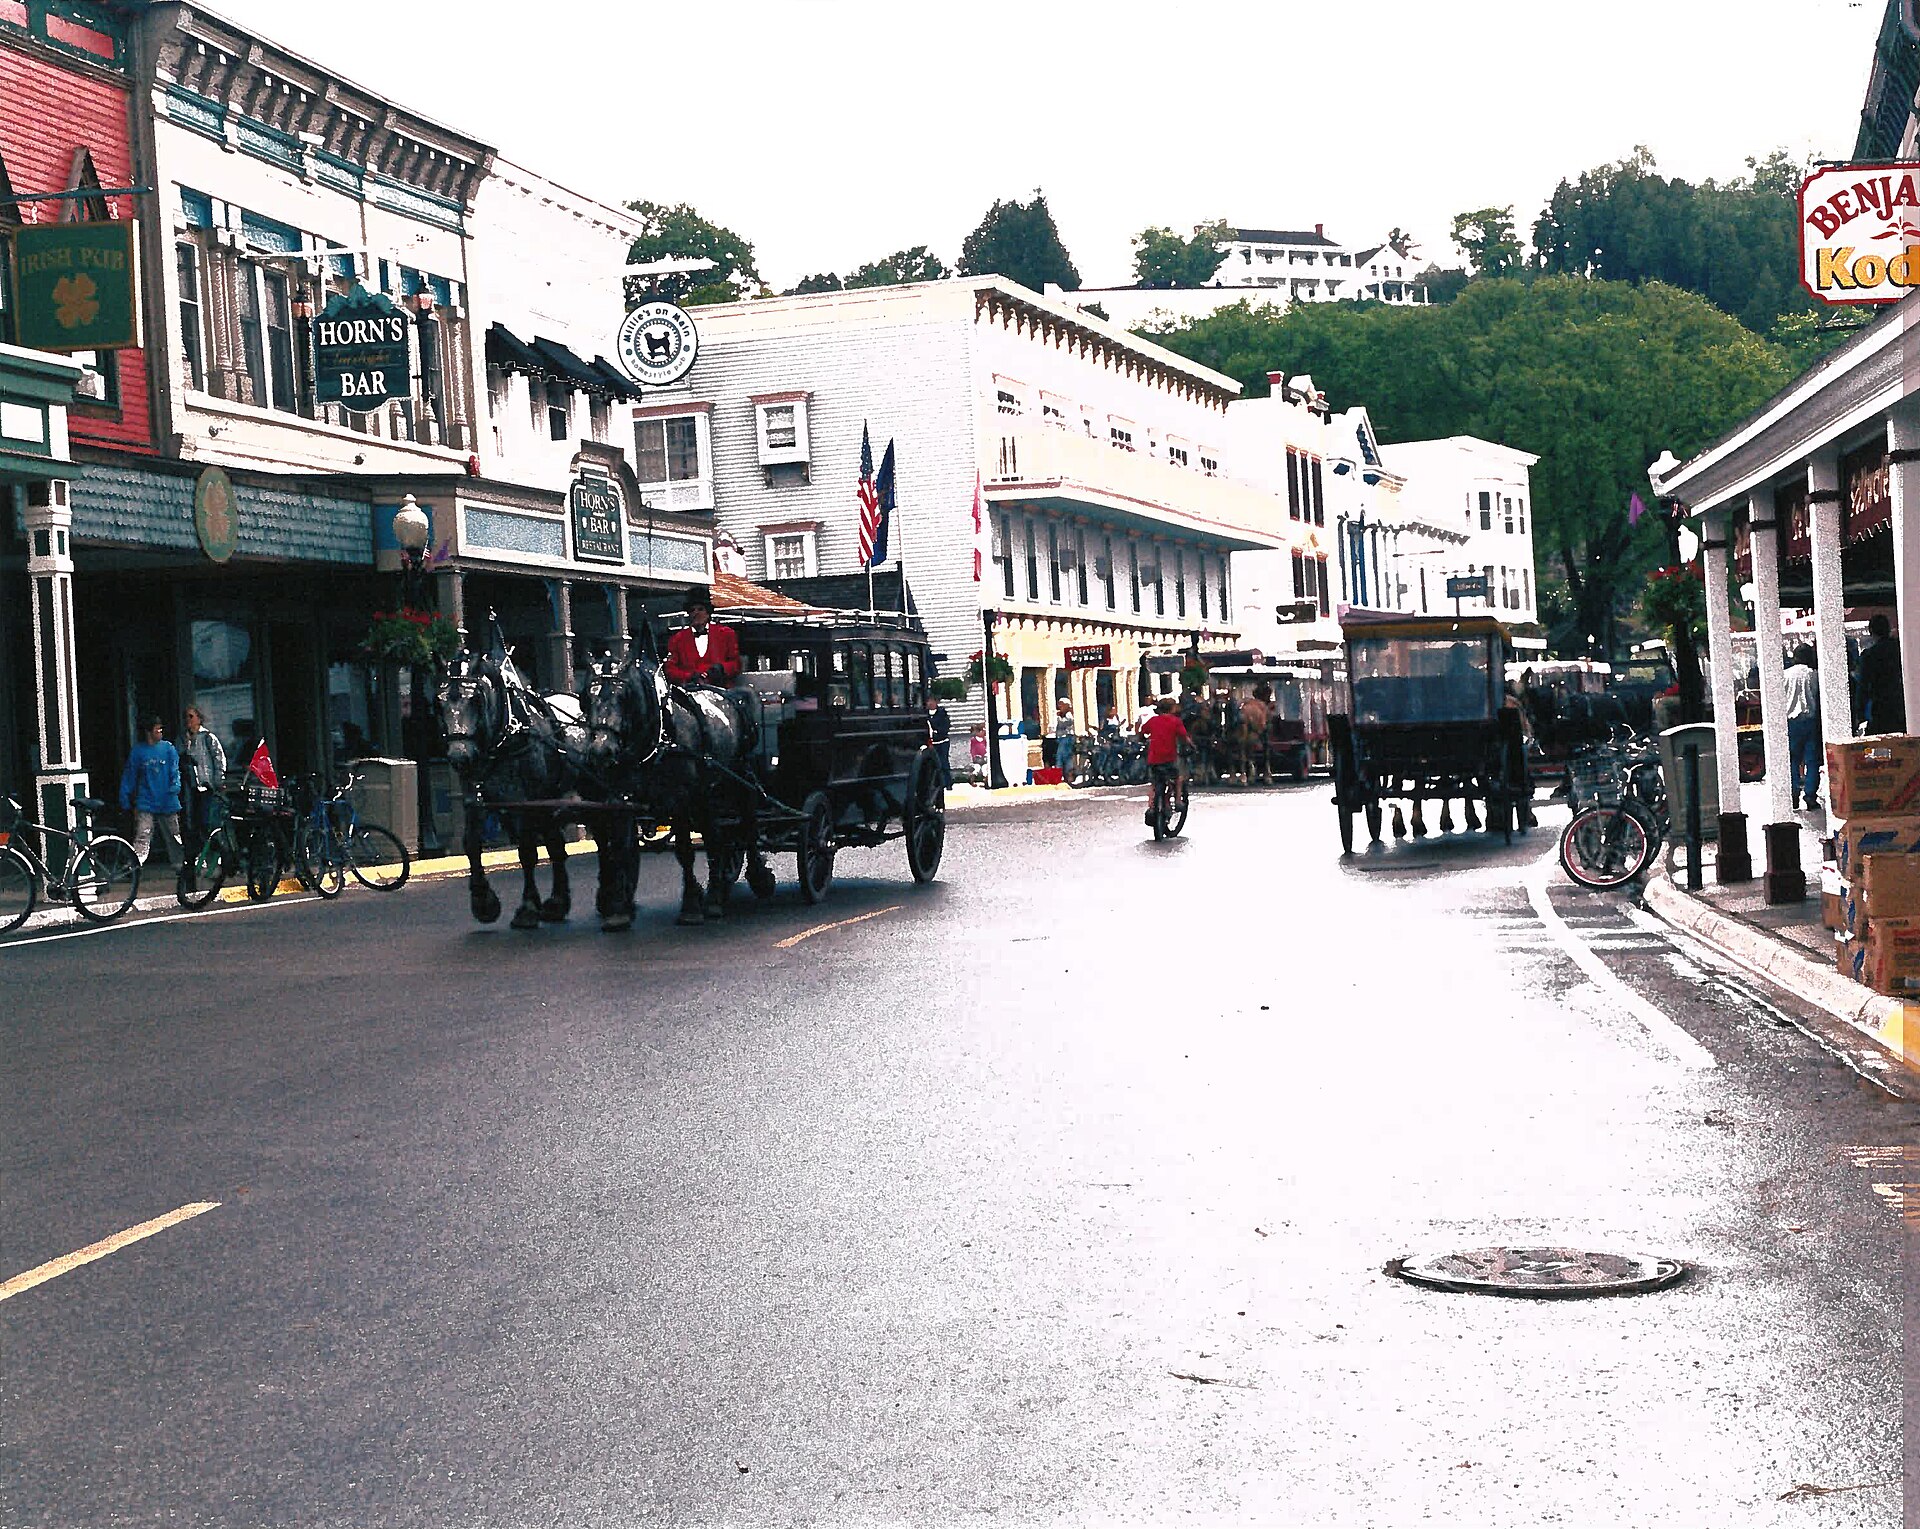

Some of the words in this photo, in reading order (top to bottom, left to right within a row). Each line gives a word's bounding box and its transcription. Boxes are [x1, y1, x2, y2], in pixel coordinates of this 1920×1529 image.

[1806, 174, 1920, 240] BENJA
[21, 247, 72, 275] IRISH
[80, 247, 125, 270] PUB
[319, 317, 403, 346] HORN'S
[623, 309, 651, 343] Millie's
[655, 308, 669, 316] on
[672, 313, 690, 337] Main
[674, 356, 686, 371] pub
[340, 370, 387, 397] BAR
[580, 491, 616, 512] HORN'S
[590, 517, 610, 534] BAR
[581, 540, 620, 553] RESTAURANT
